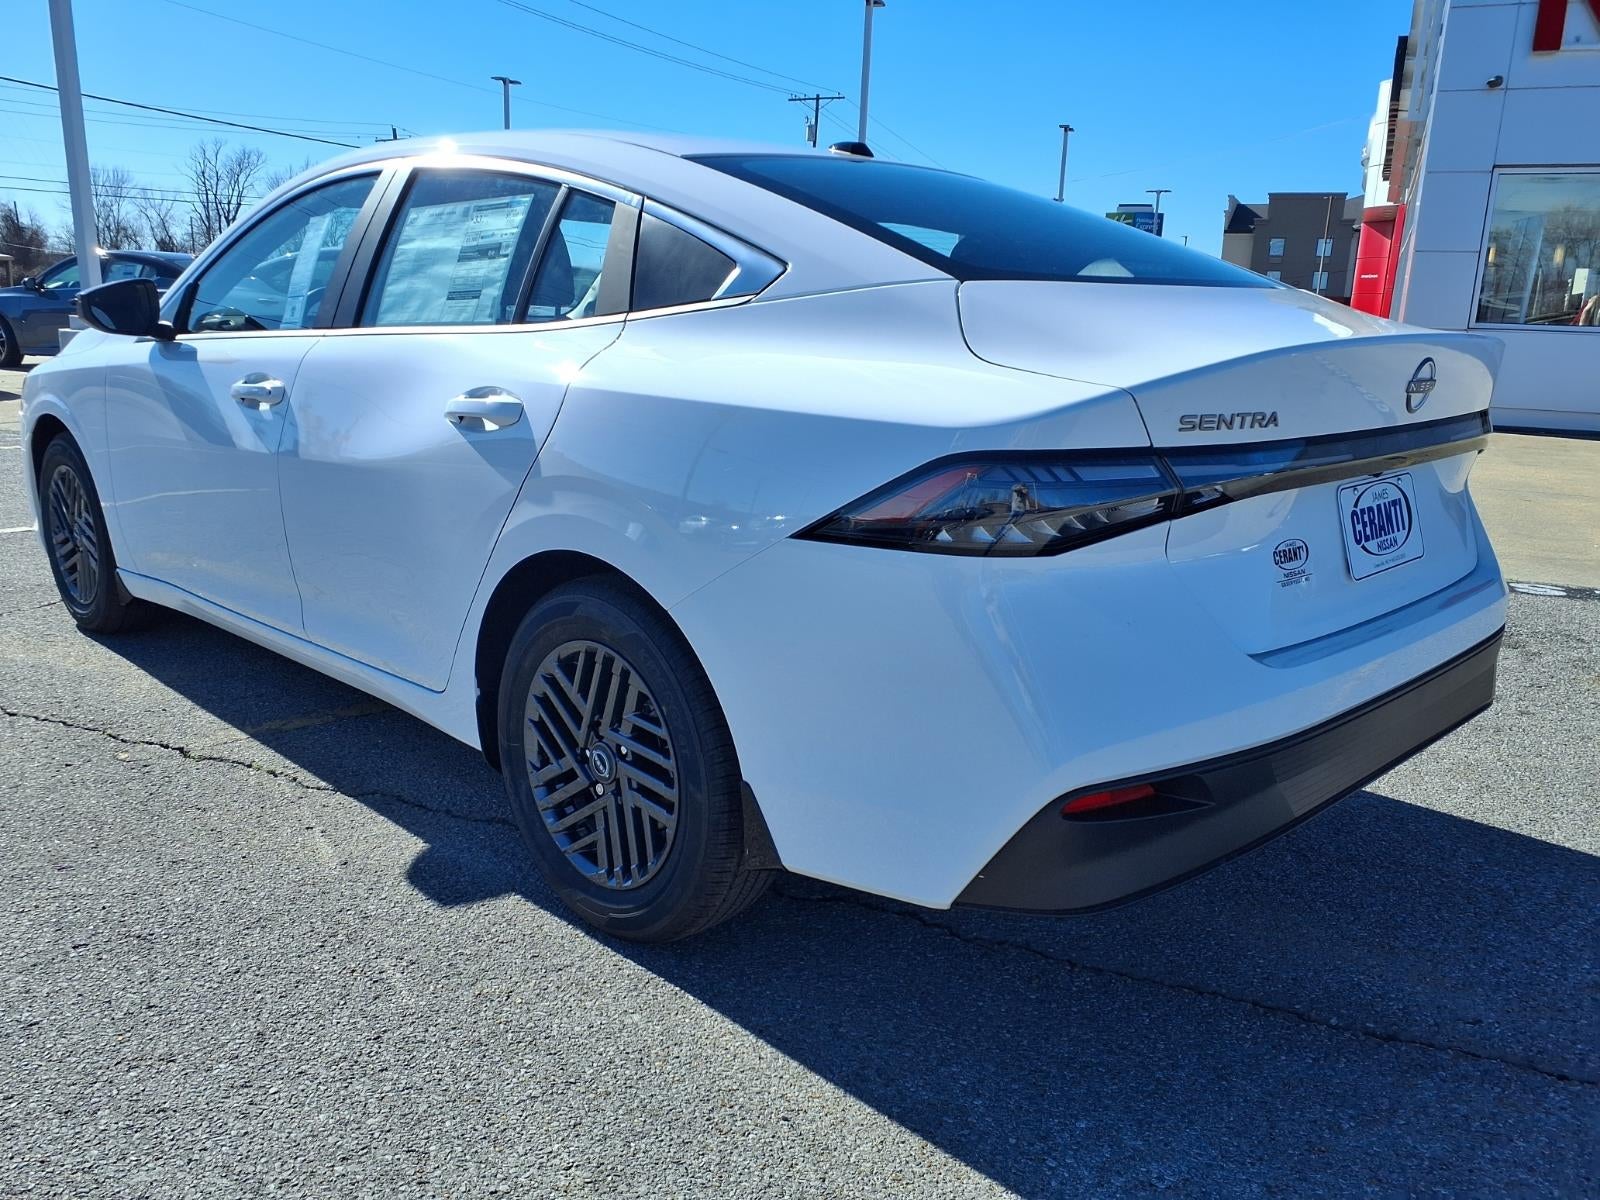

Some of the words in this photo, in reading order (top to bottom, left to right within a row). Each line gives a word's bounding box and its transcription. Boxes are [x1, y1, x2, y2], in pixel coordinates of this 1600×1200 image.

[1136, 223, 1159, 231] Expres
[1408, 381, 1434, 392] NISSA
[1178, 411, 1279, 432] SENTRA
[1372, 488, 1389, 502] JAMES
[1351, 498, 1406, 545] CERANTI
[1377, 536, 1399, 553] NISSAN
[1283, 568, 1306, 579] NISSAN
